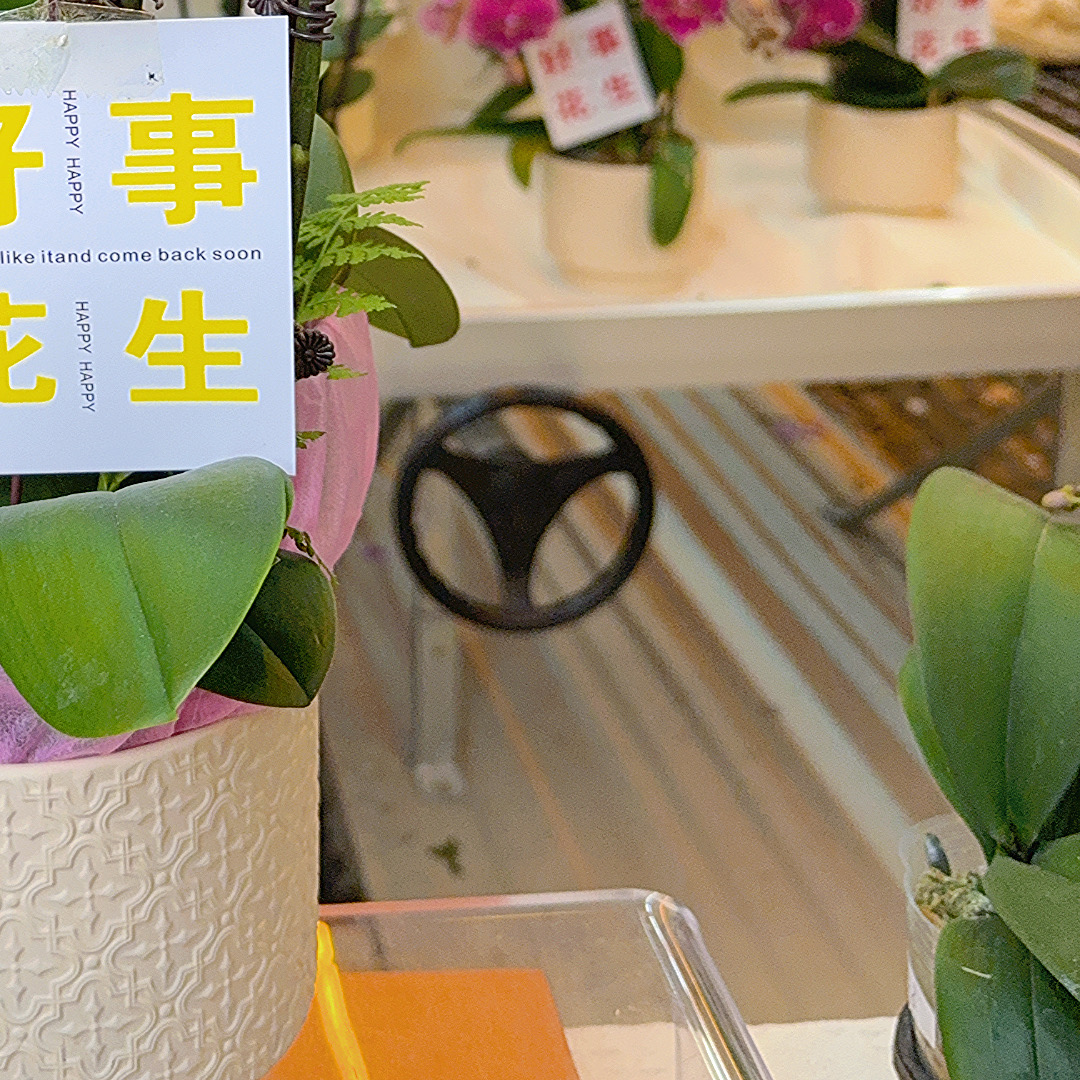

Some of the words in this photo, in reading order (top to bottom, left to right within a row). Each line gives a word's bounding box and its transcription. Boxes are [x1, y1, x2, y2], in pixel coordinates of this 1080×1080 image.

[61, 89, 81, 149] HAPPY
[65, 156, 85, 216] HAPPY
[0, 249, 35, 265] like
[41, 248, 91, 264] itand
[97, 250, 152, 263] come
[158, 247, 207, 262] back
[212, 248, 261, 261] soon
[74, 300, 93, 355] HAPPY
[78, 360, 97, 413] HAPPY
